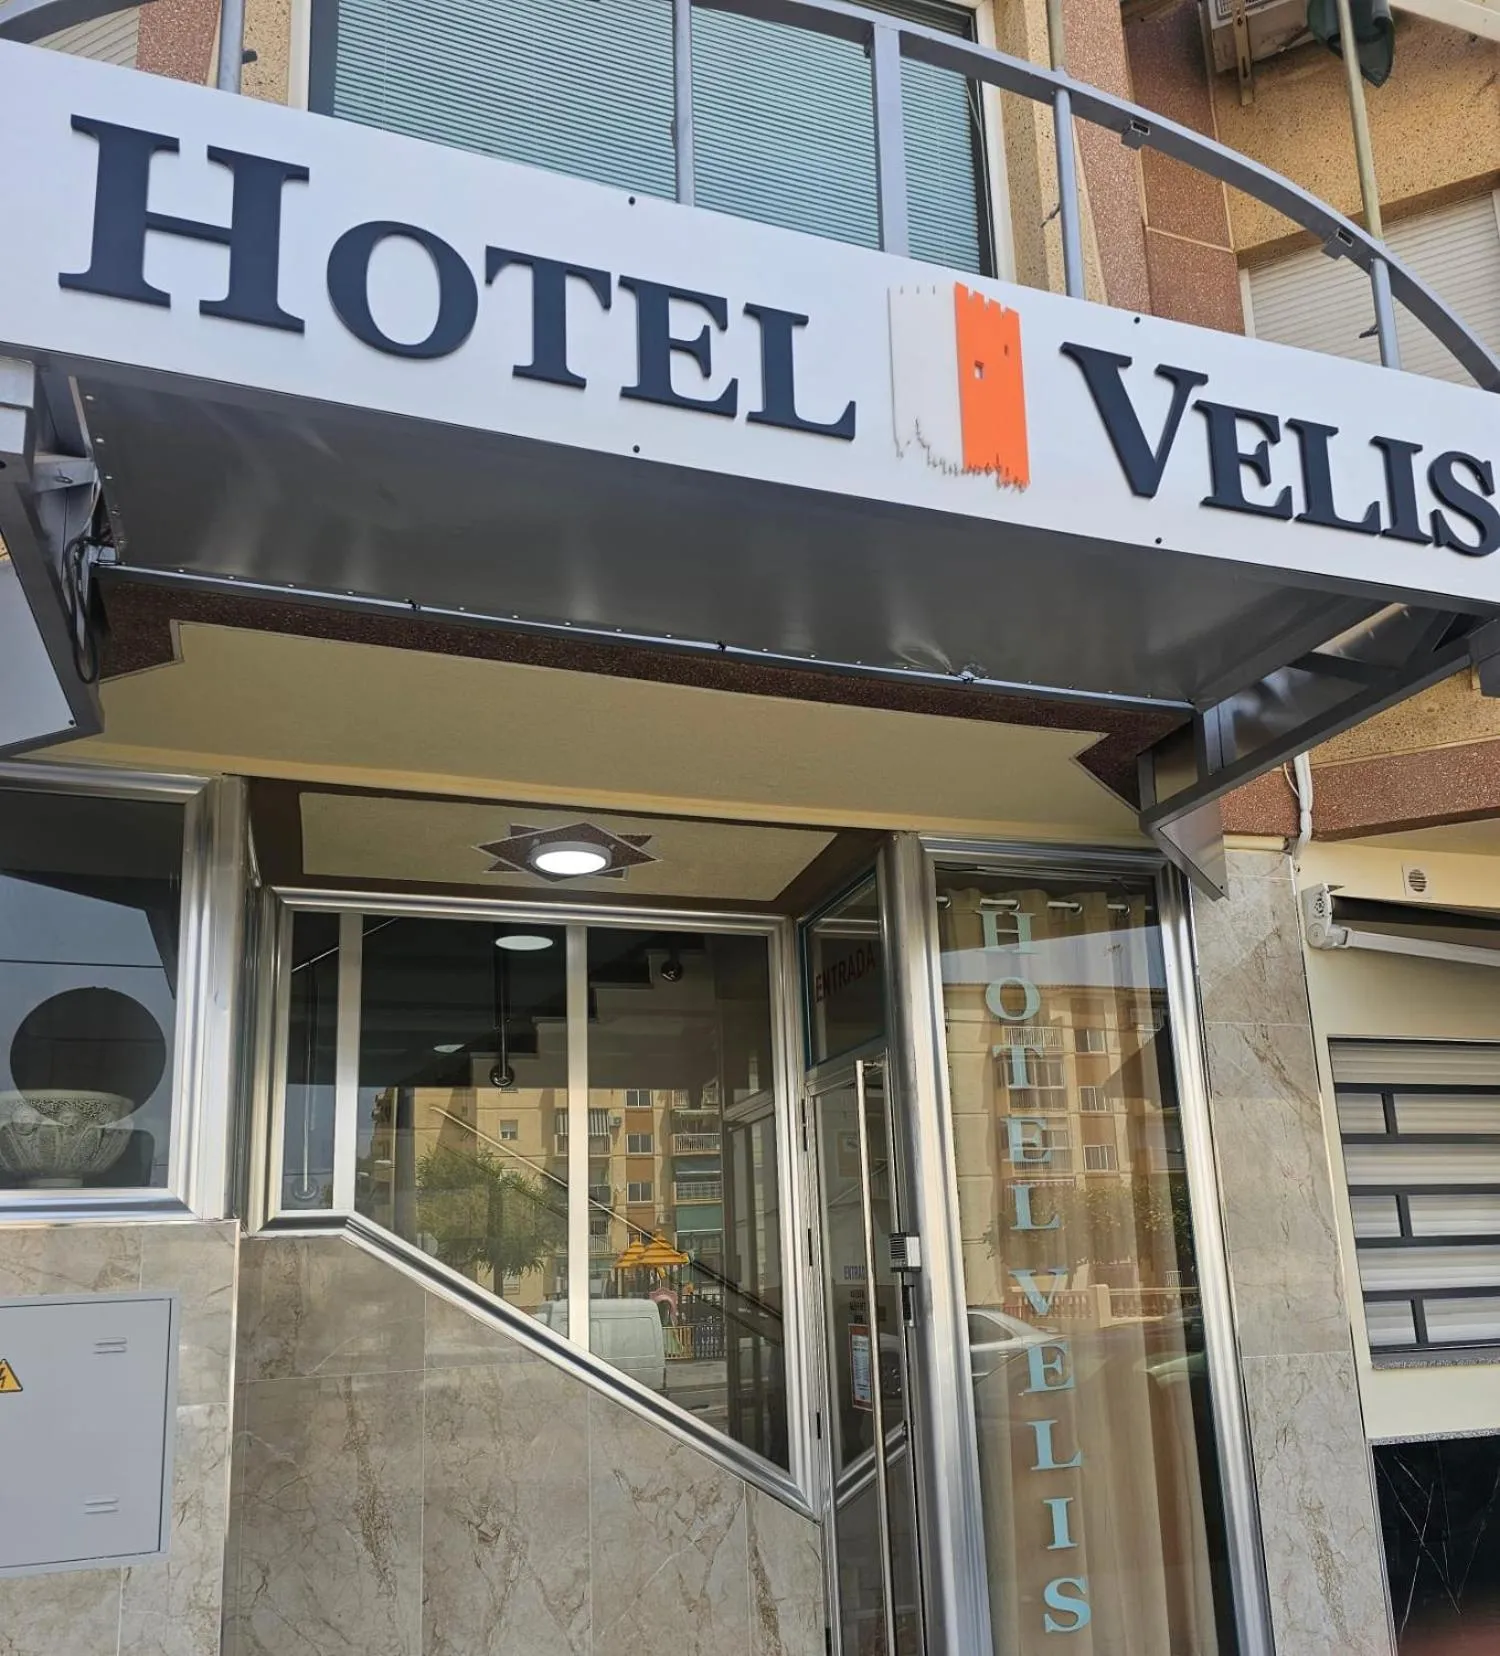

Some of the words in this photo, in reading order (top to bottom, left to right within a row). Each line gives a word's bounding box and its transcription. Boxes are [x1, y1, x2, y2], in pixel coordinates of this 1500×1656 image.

[58, 115, 856, 442] HOTEL
[1061, 341, 1500, 557] VELIS
[815, 941, 876, 1003] ENTRADA
[975, 909, 1061, 1231] HOTEL
[1010, 1268, 1091, 1633] VELIS
